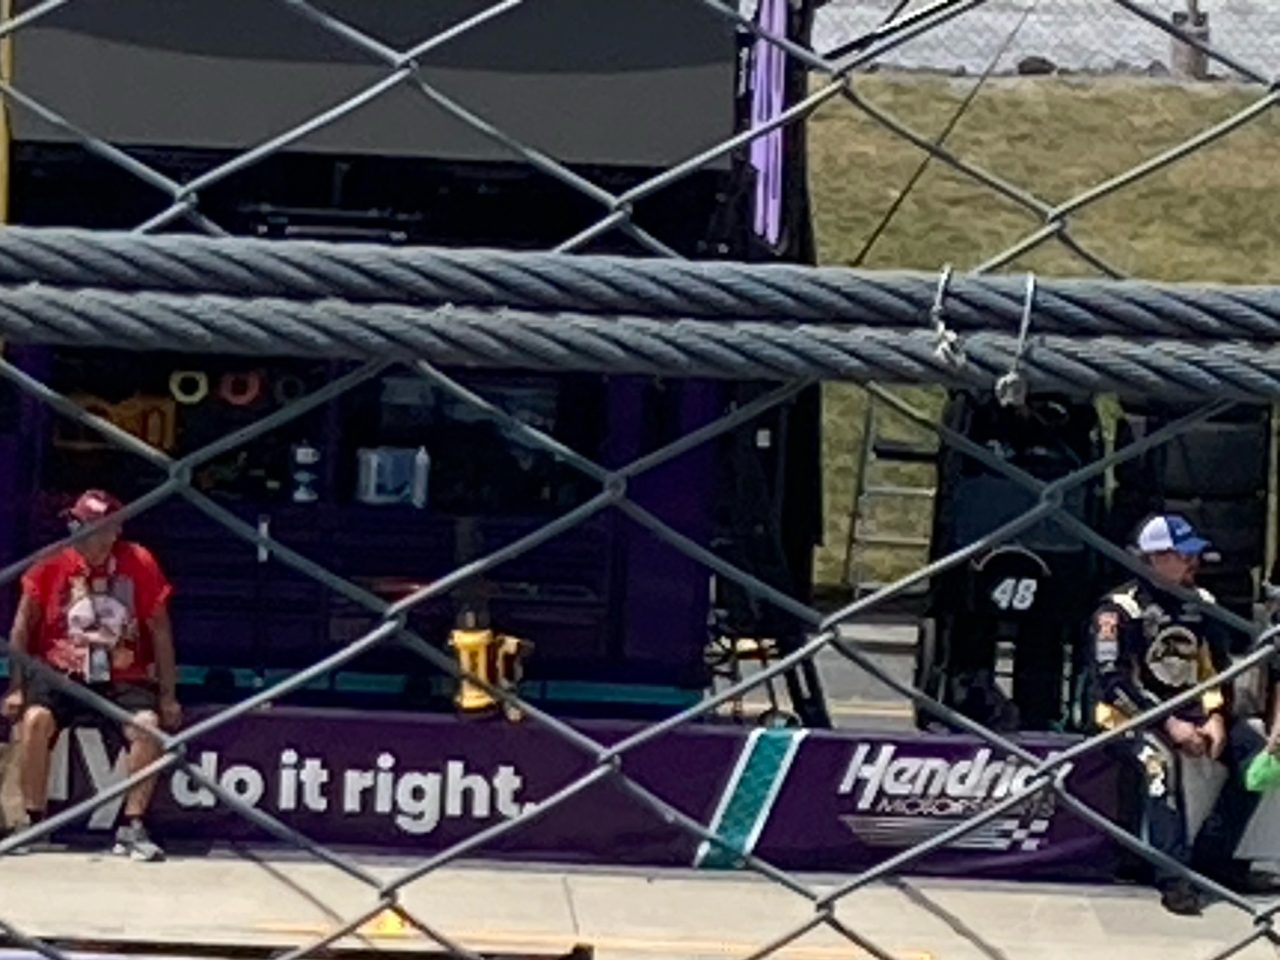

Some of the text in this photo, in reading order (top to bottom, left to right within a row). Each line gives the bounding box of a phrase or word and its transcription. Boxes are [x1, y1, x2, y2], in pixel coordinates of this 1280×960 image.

[991, 578, 1038, 611] 48
[171, 750, 264, 808] do
[278, 748, 329, 812] it
[343, 751, 542, 834] right.
